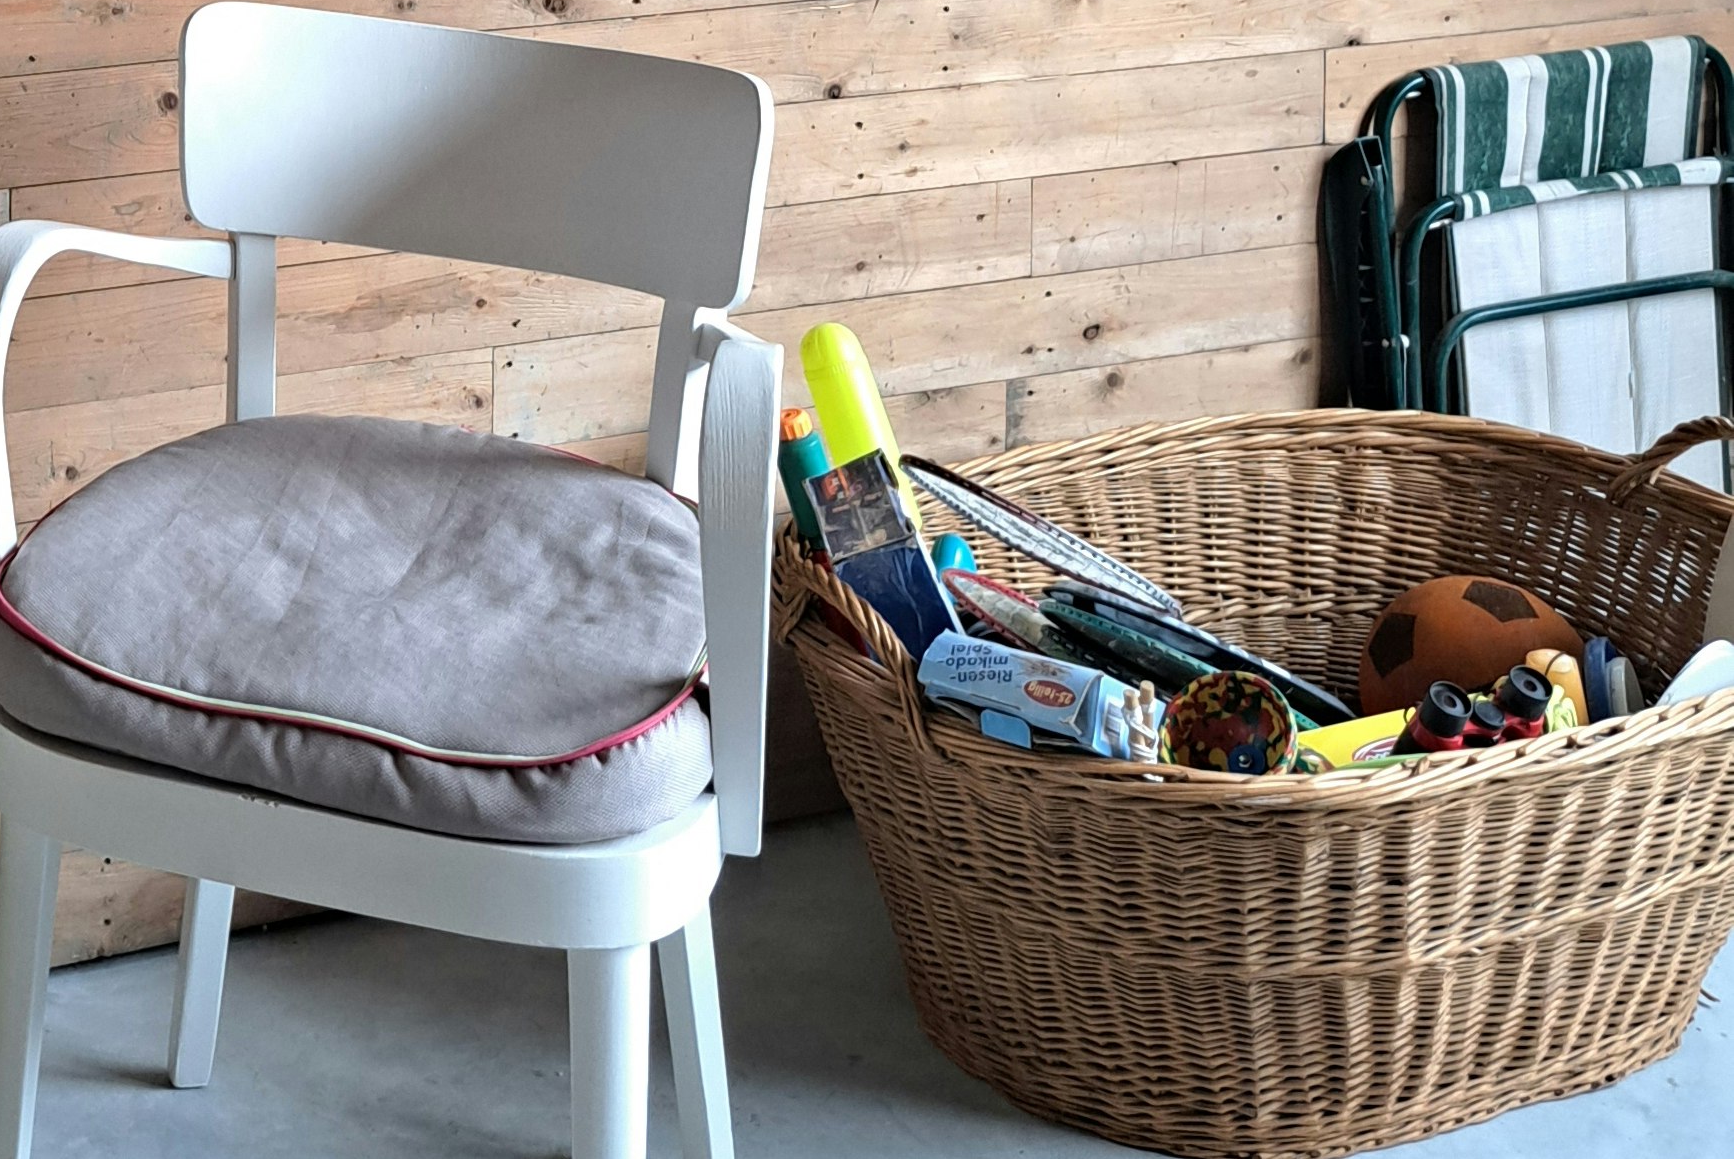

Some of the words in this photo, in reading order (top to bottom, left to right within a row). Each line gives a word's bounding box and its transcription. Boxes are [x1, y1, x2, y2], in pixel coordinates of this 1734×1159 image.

[951, 644, 992, 655] Spiel
[938, 656, 1009, 669] mikado-
[950, 670, 1012, 682] Riesen-
